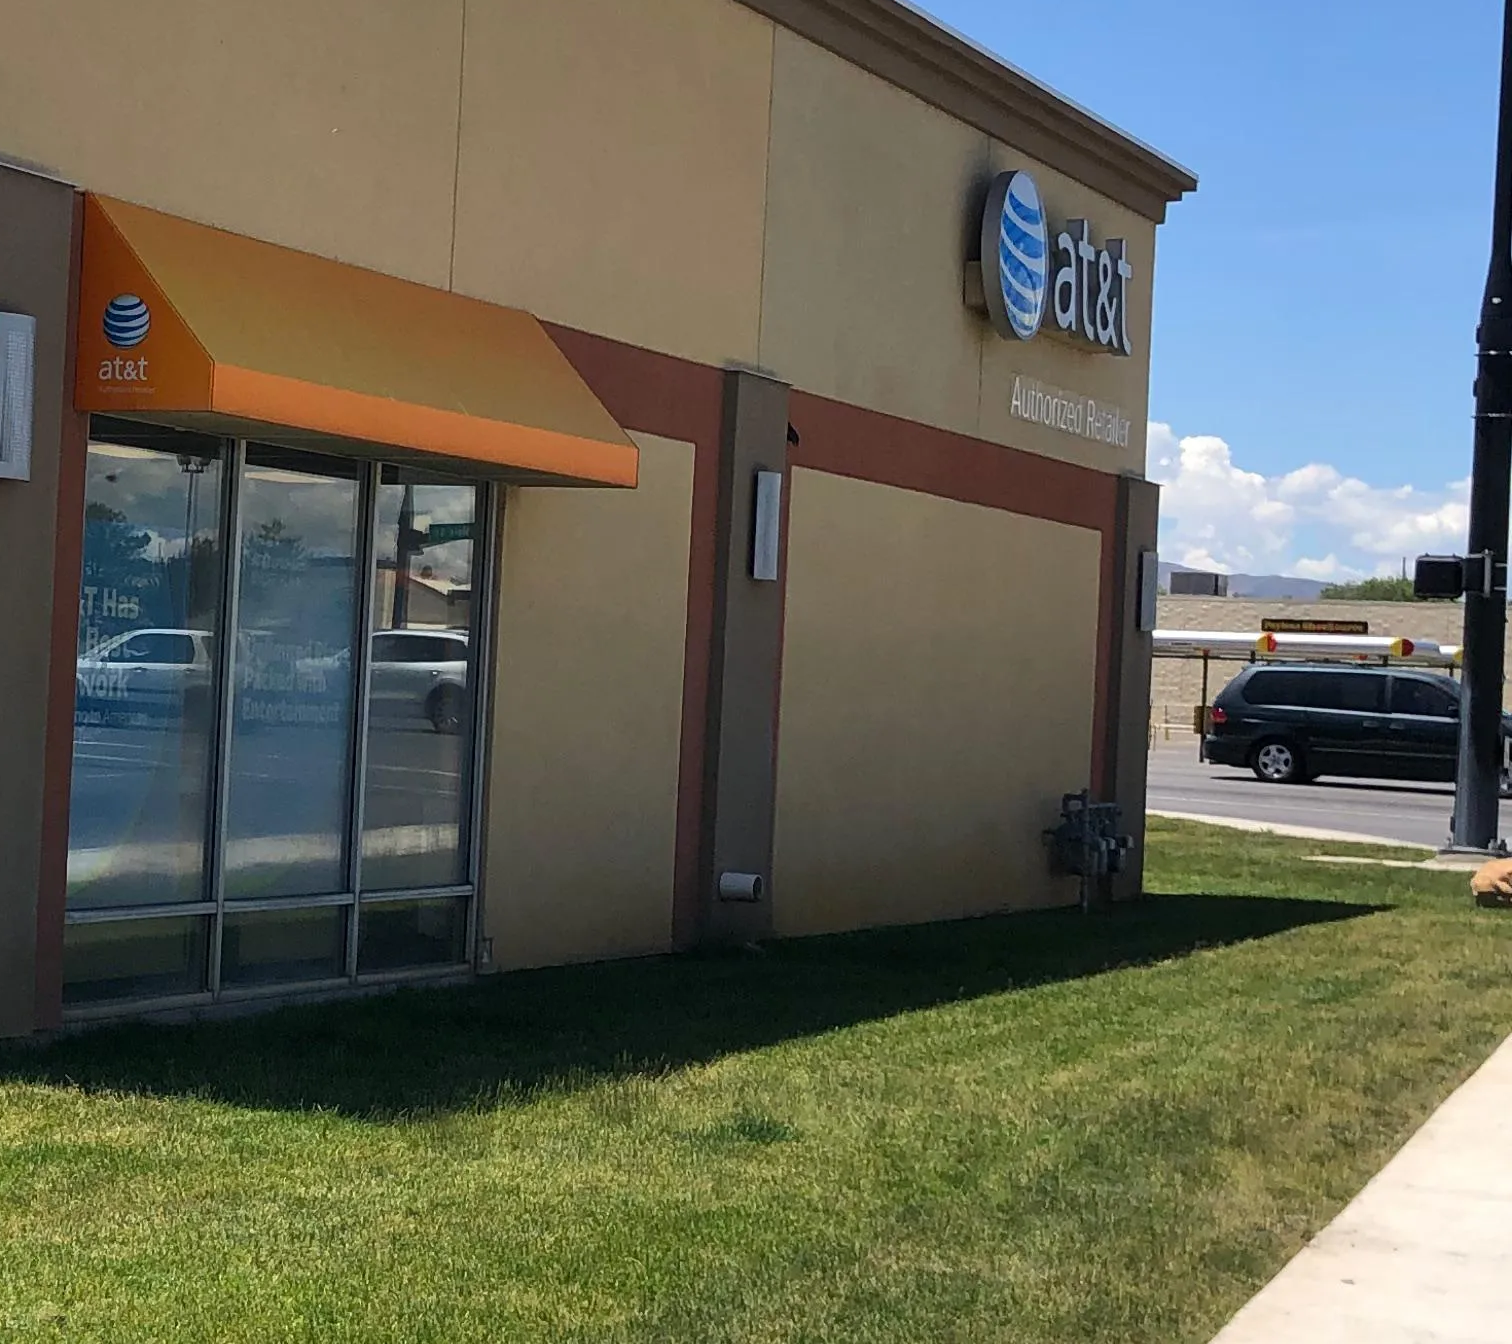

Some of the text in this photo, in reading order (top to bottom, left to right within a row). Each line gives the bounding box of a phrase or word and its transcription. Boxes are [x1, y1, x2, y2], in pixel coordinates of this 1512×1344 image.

[1054, 218, 1132, 356] at&t
[98, 356, 149, 382] at&t
[1010, 376, 1132, 448] Authorized Retailer
[103, 587, 140, 619] Has
